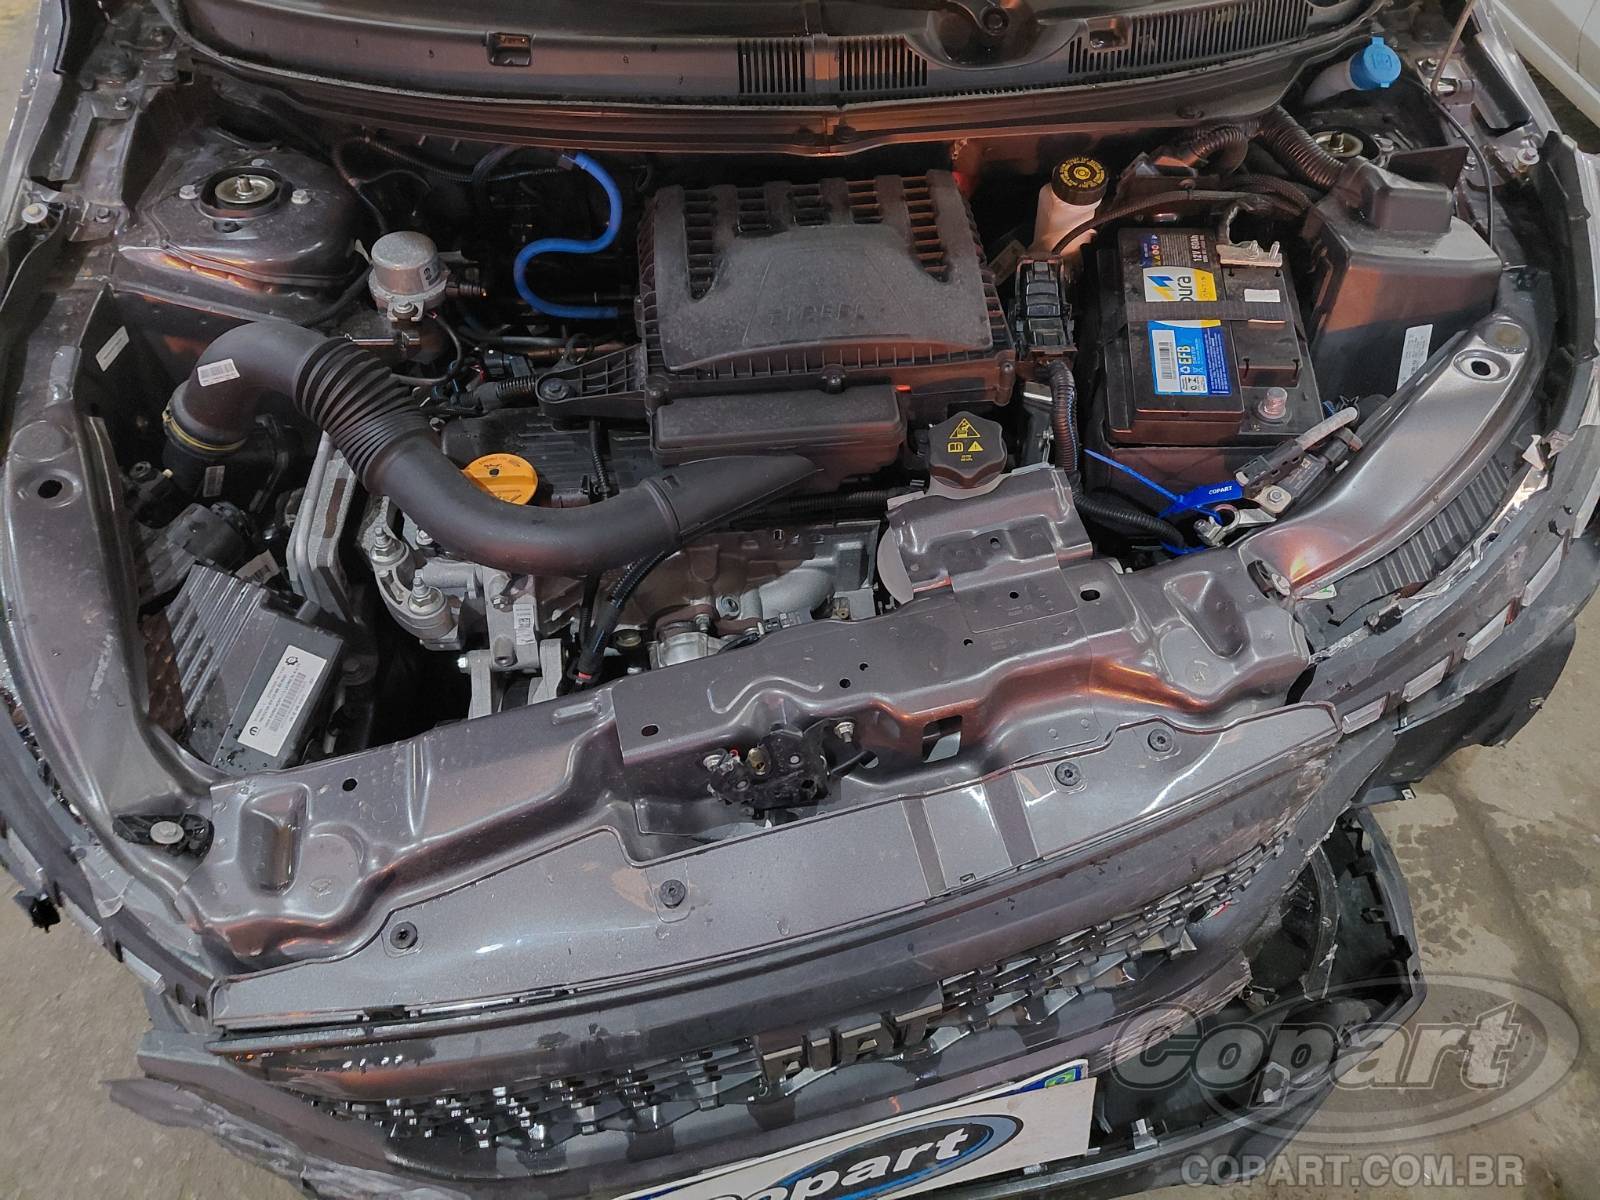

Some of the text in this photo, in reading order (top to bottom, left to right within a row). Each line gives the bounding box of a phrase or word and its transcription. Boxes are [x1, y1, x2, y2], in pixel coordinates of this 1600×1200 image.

[1192, 250, 1203, 262] 12V
[1177, 345, 1192, 365] EFB
[1208, 485, 1233, 495] COPART
